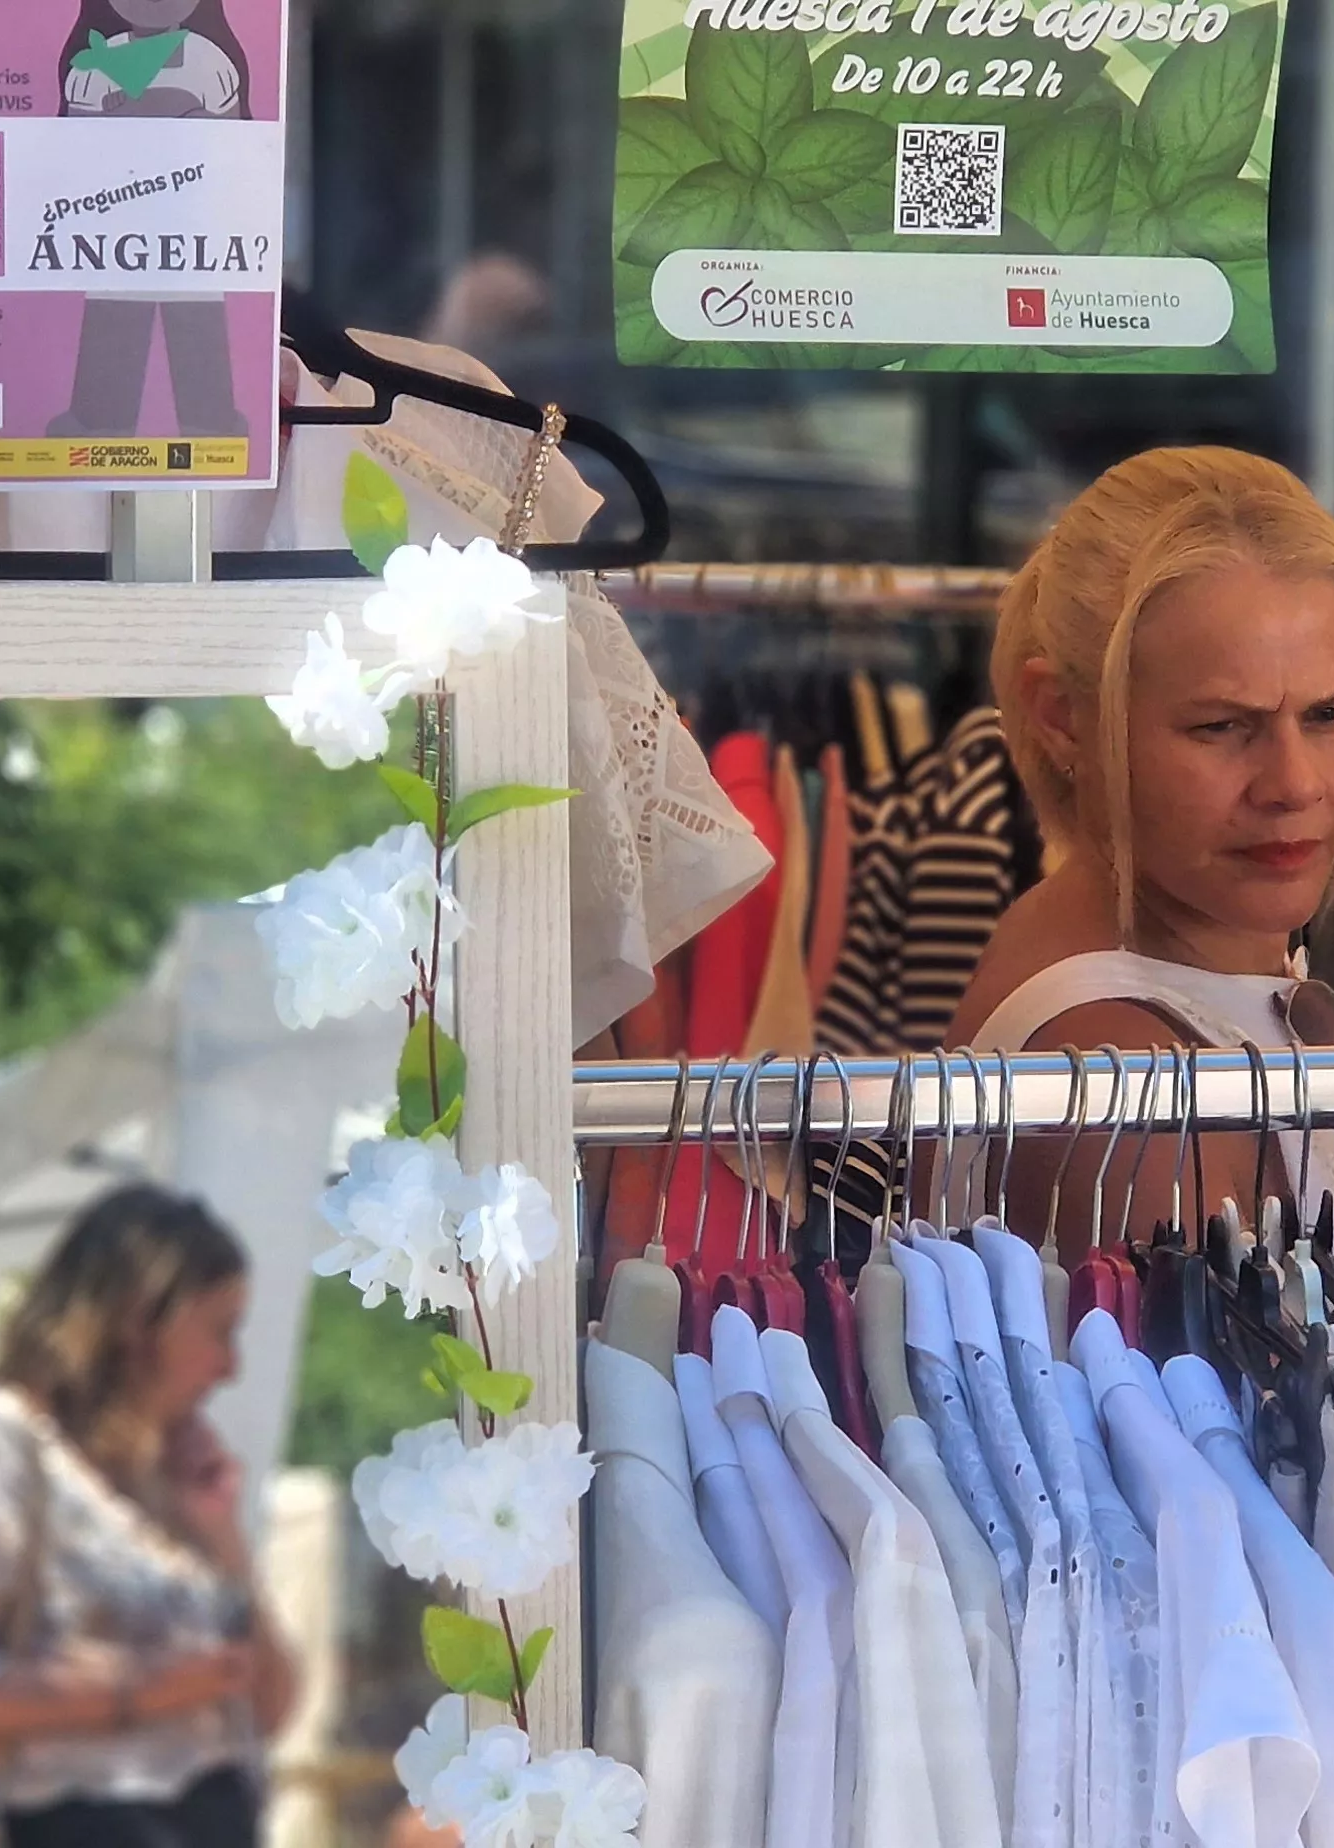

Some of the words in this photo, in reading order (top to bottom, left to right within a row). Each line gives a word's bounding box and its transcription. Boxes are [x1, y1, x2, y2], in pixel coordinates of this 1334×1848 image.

[683, 0, 895, 34] Huesca
[947, 0, 1022, 38] de
[1033, 0, 1230, 52] agosto
[832, 53, 884, 94] De
[892, 55, 943, 95] 10
[945, 69, 970, 96] a
[976, 58, 1034, 98] 22
[1035, 60, 1064, 99] h
[42, 174, 168, 223] ¿Preguntas
[171, 162, 206, 192] por
[27, 223, 270, 273] ÁNGELA?
[701, 260, 764, 271] ORGANIZA:
[1005, 265, 1062, 276] FINANCIA:
[751, 288, 854, 307] COMERCIO
[1051, 288, 1181, 311] Ayuntamiento
[751, 309, 855, 329] HUESCA
[1051, 311, 1074, 329] de
[1080, 311, 1151, 330] Huesca
[91, 445, 151, 456] GOBIERNO
[91, 456, 106, 467] DE
